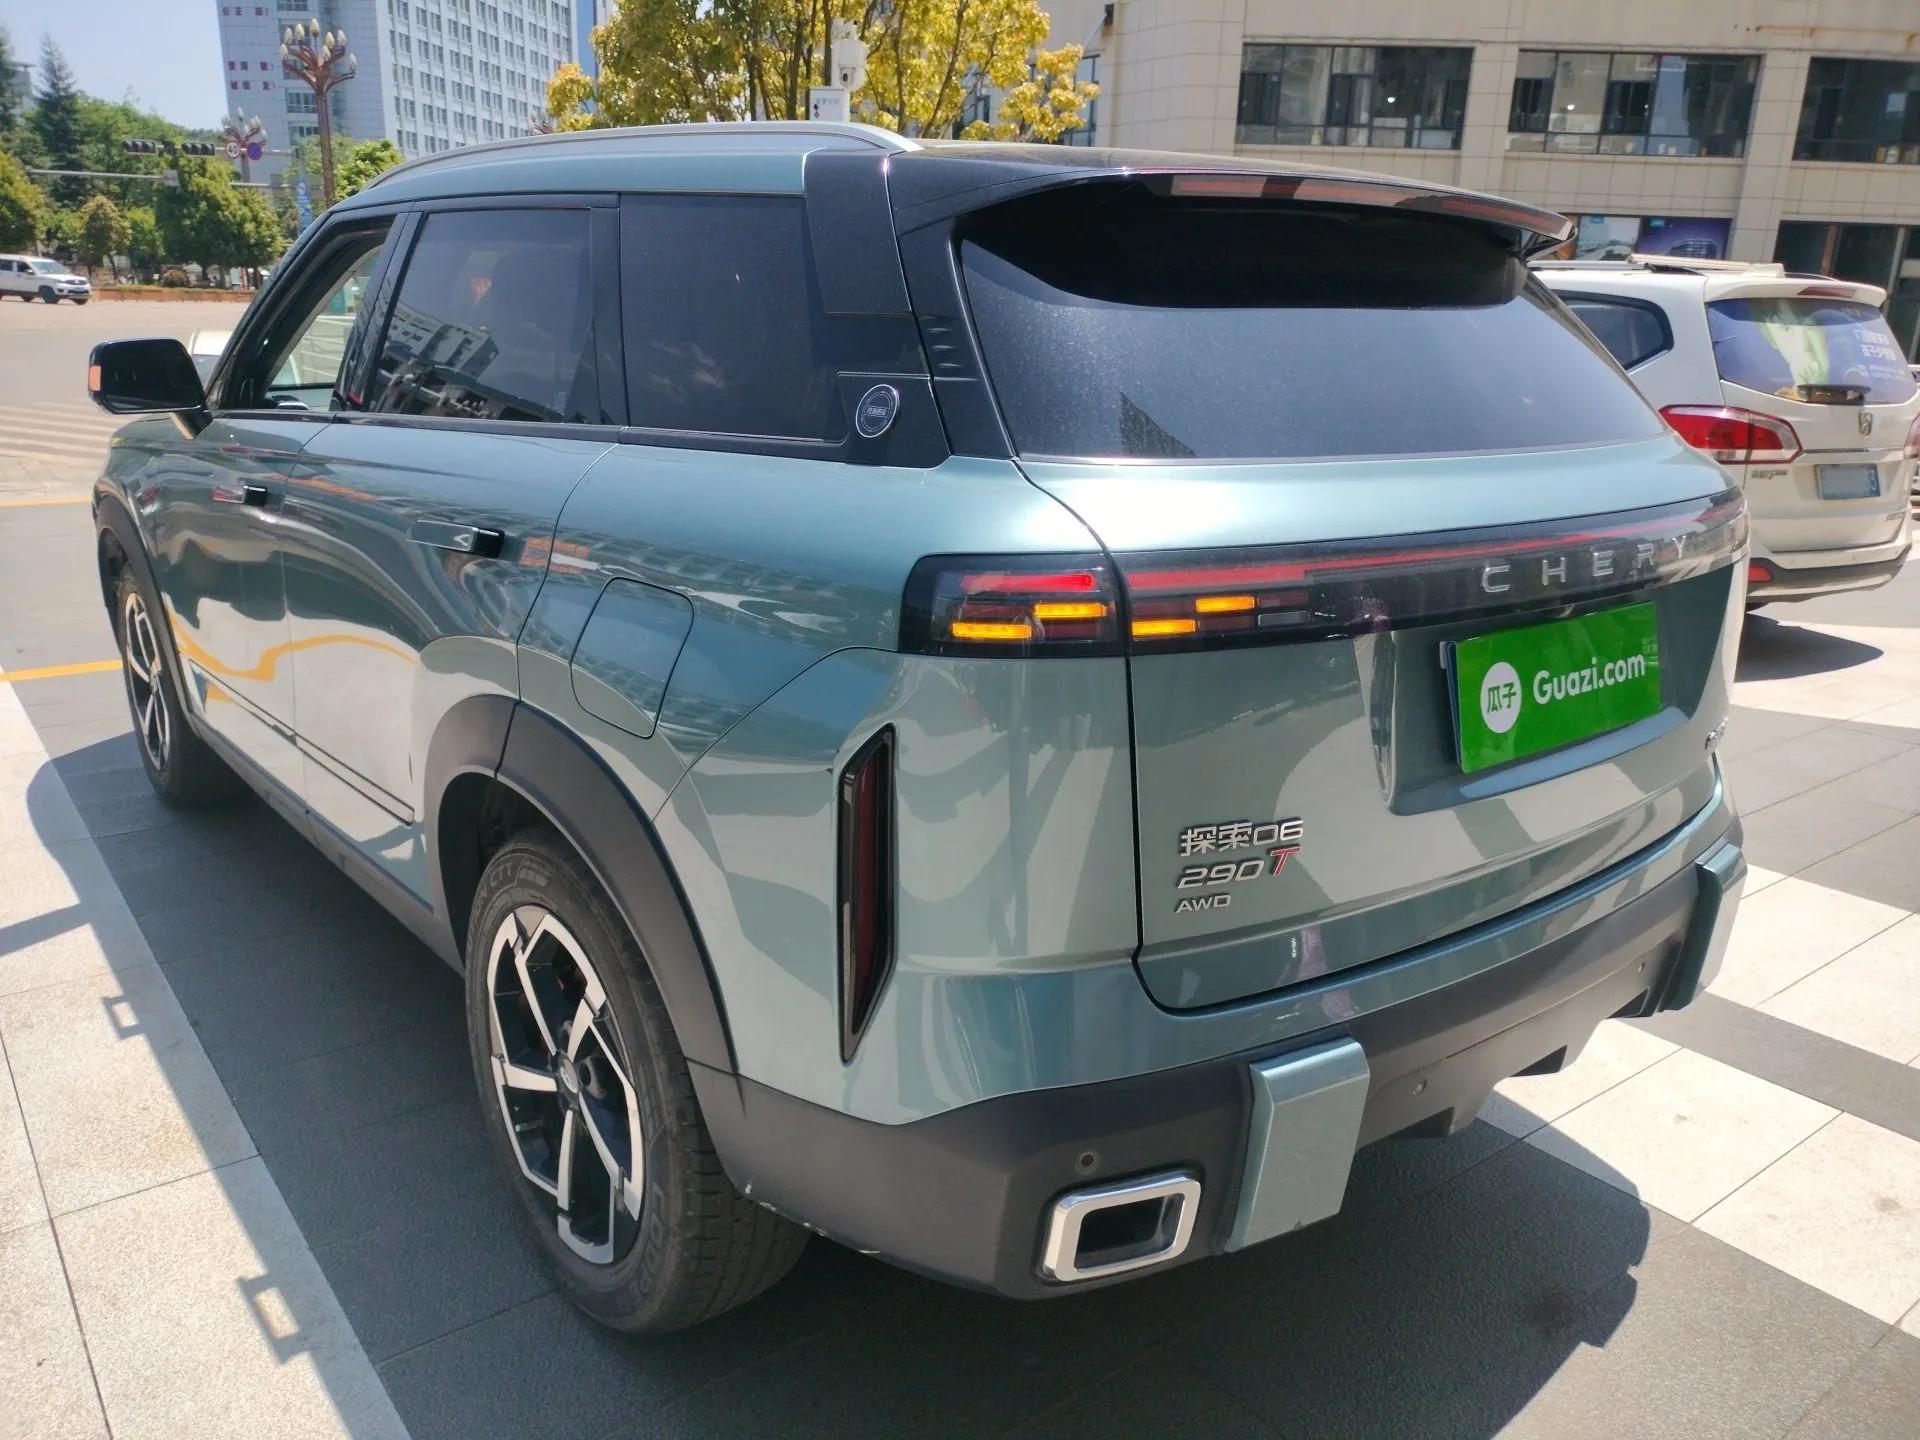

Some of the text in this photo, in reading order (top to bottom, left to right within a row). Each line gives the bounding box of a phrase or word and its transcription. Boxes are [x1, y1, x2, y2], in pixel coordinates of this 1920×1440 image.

[1481, 534, 1687, 593] CHERY
[1486, 682, 1517, 714] 瓜子
[1532, 653, 1645, 705] Guazi.com
[1180, 819, 1304, 857] 探索06
[1175, 894, 1232, 914] AWD
